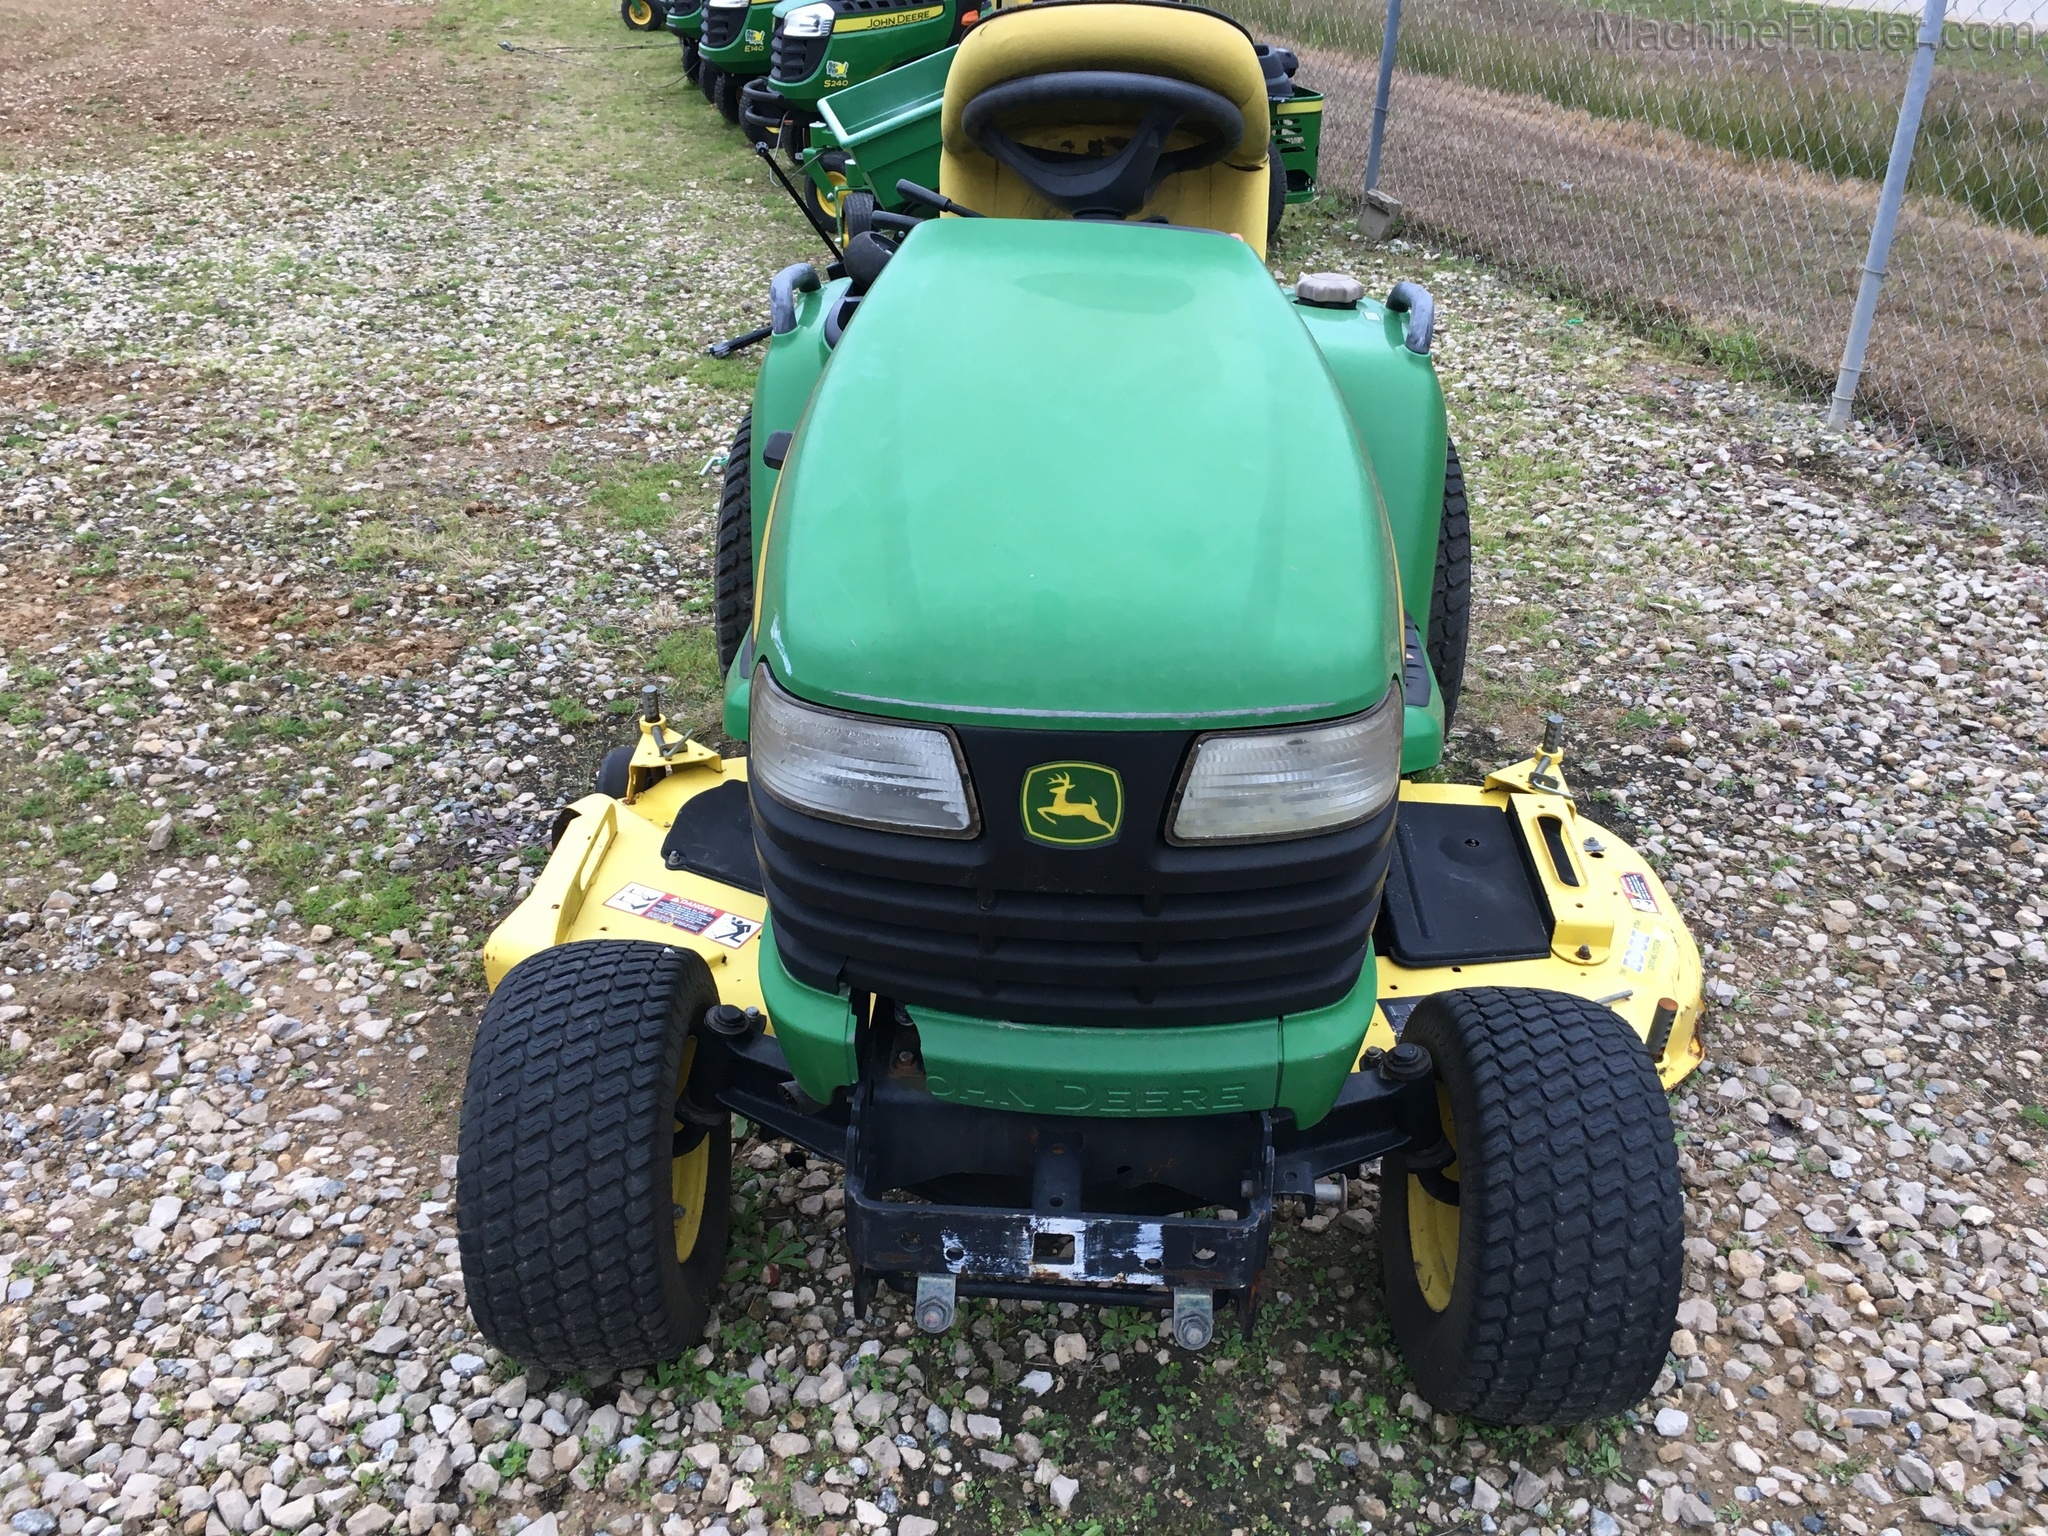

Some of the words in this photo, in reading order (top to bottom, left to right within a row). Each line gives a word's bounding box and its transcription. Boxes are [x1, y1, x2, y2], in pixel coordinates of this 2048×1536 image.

[867, 17, 895, 28] JOHN
[897, 10, 930, 24] DEERE
[680, 898, 716, 914] DANGER
[925, 1075, 1035, 1108] OHN
[1054, 1079, 1246, 1112] DEERE
